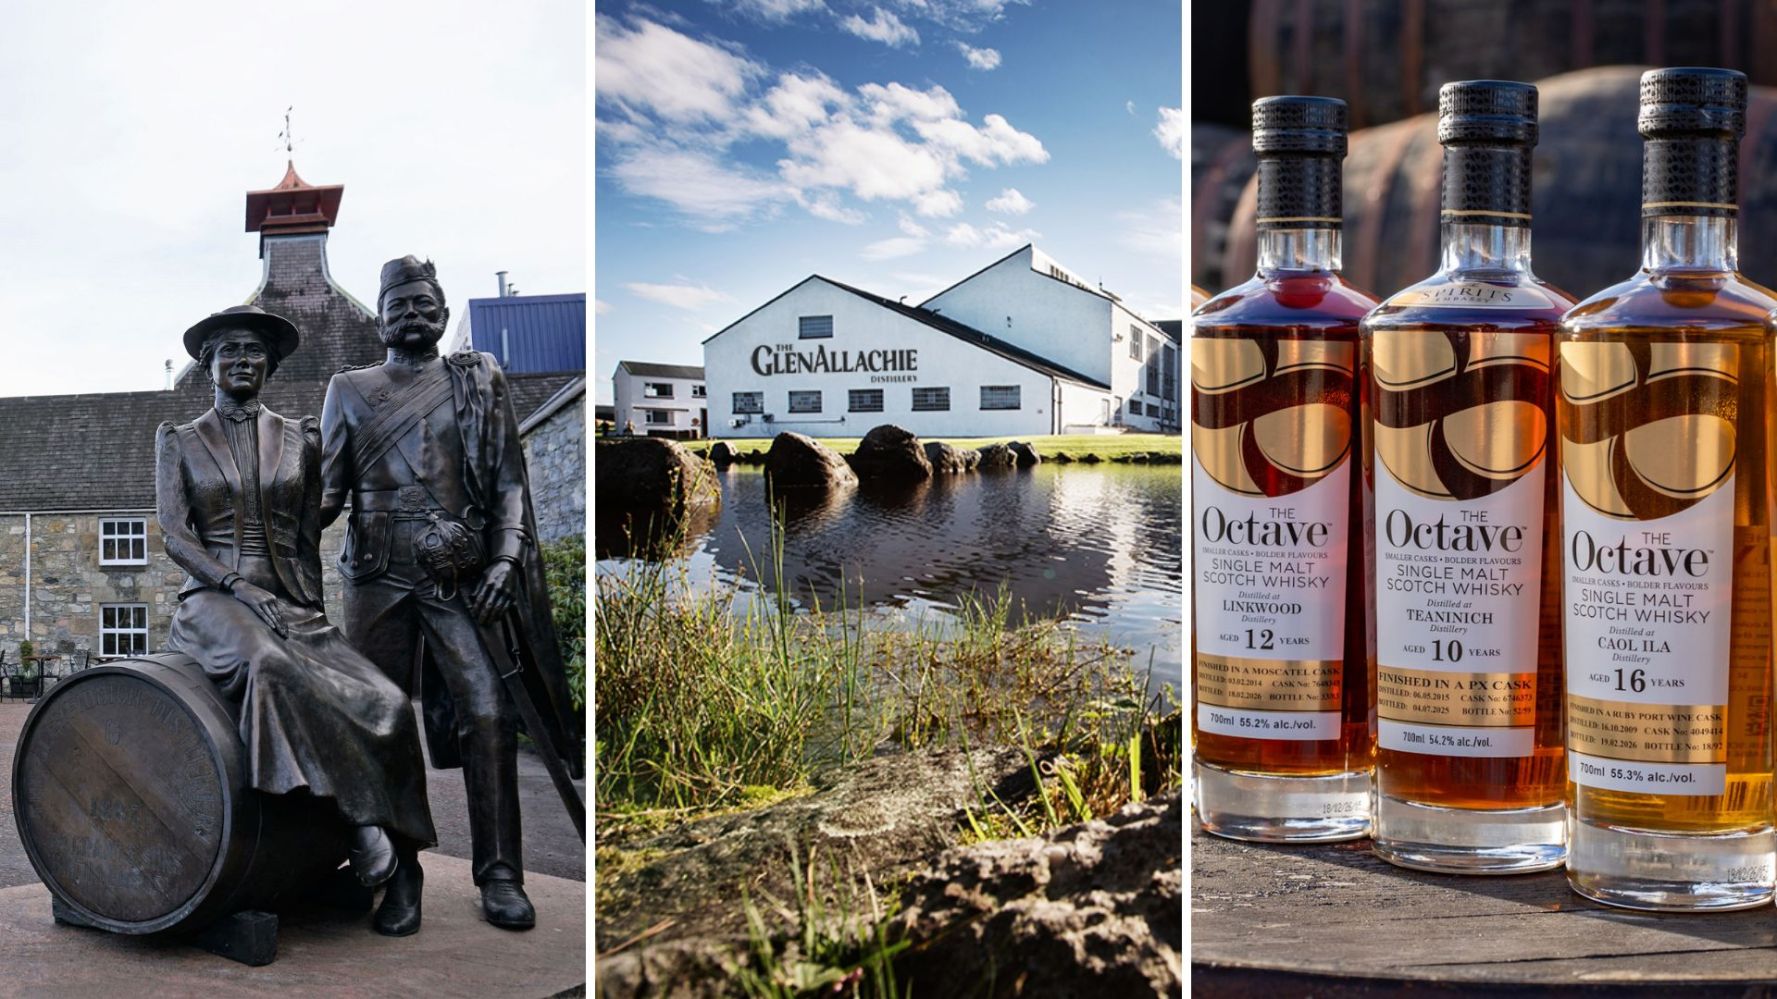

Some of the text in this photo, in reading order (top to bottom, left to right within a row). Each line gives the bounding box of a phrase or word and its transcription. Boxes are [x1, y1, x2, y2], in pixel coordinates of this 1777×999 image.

[1424, 288, 1513, 302] SPIRITS
[871, 375, 917, 383] DISTILLERY
[1269, 508, 1295, 519] THE
[1460, 510, 1488, 522] THE
[1642, 532, 1671, 545] THE
[1385, 552, 1413, 561] SMALLER
[1414, 555, 1438, 563] CASKS
[1212, 559, 1314, 574] SINGLE MALT
[1397, 564, 1509, 580] SINGLE MALT
[1204, 571, 1330, 588] SCOTCH WHISKY
[1597, 579, 1620, 587] CASKS
[1627, 581, 1661, 589] BOLDER
[1663, 582, 1709, 590] FLAVOURS
[1387, 578, 1524, 596] SCOTCH WHISKY
[1238, 591, 1270, 599] Distilled
[1582, 588, 1694, 608] SINGLE MALT
[1223, 600, 1302, 615] LINKWOOD
[1427, 599, 1460, 608] Distilled
[1241, 615, 1276, 625] Distillery
[1407, 609, 1493, 624] TEANINICH
[1573, 603, 1711, 624] SCOTCH WHISKY
[1430, 625, 1468, 635] Distillery
[1609, 626, 1643, 636] Distilled
[1220, 629, 1309, 650] AGED 12 YEARS
[1598, 636, 1672, 653] CAOL ILA
[1403, 645, 1425, 653] AGED
[1431, 639, 1463, 662] 10
[1612, 653, 1651, 665] Distillery
[1272, 680, 1294, 688] CASK
[1379, 671, 1531, 690] FINISHED IN A PX CASK
[1588, 668, 1685, 693] AGED 16 YEARS
[1379, 686, 1411, 697] DISTILLED:
[1413, 691, 1449, 700] 06.05.2015
[1379, 699, 1407, 710] BOTTLED:
[1413, 704, 1449, 714] 04.07.2025
[1210, 713, 1316, 729] 700ml 55.2% alc./vol.
[1596, 708, 1604, 716] IN
[1606, 709, 1612, 717] A
[1613, 710, 1636, 720] RUBY
[1639, 713, 1665, 721] PORT
[1667, 714, 1692, 722] WINE
[1601, 723, 1638, 734] 16.10.2009
[1644, 727, 1670, 736] CASK
[1403, 732, 1492, 747] 700ml 54.2% alc./vol.
[1644, 742, 1685, 751] BOTTLE
[1580, 763, 1696, 783] 700ml 55.3% alc./vol.
